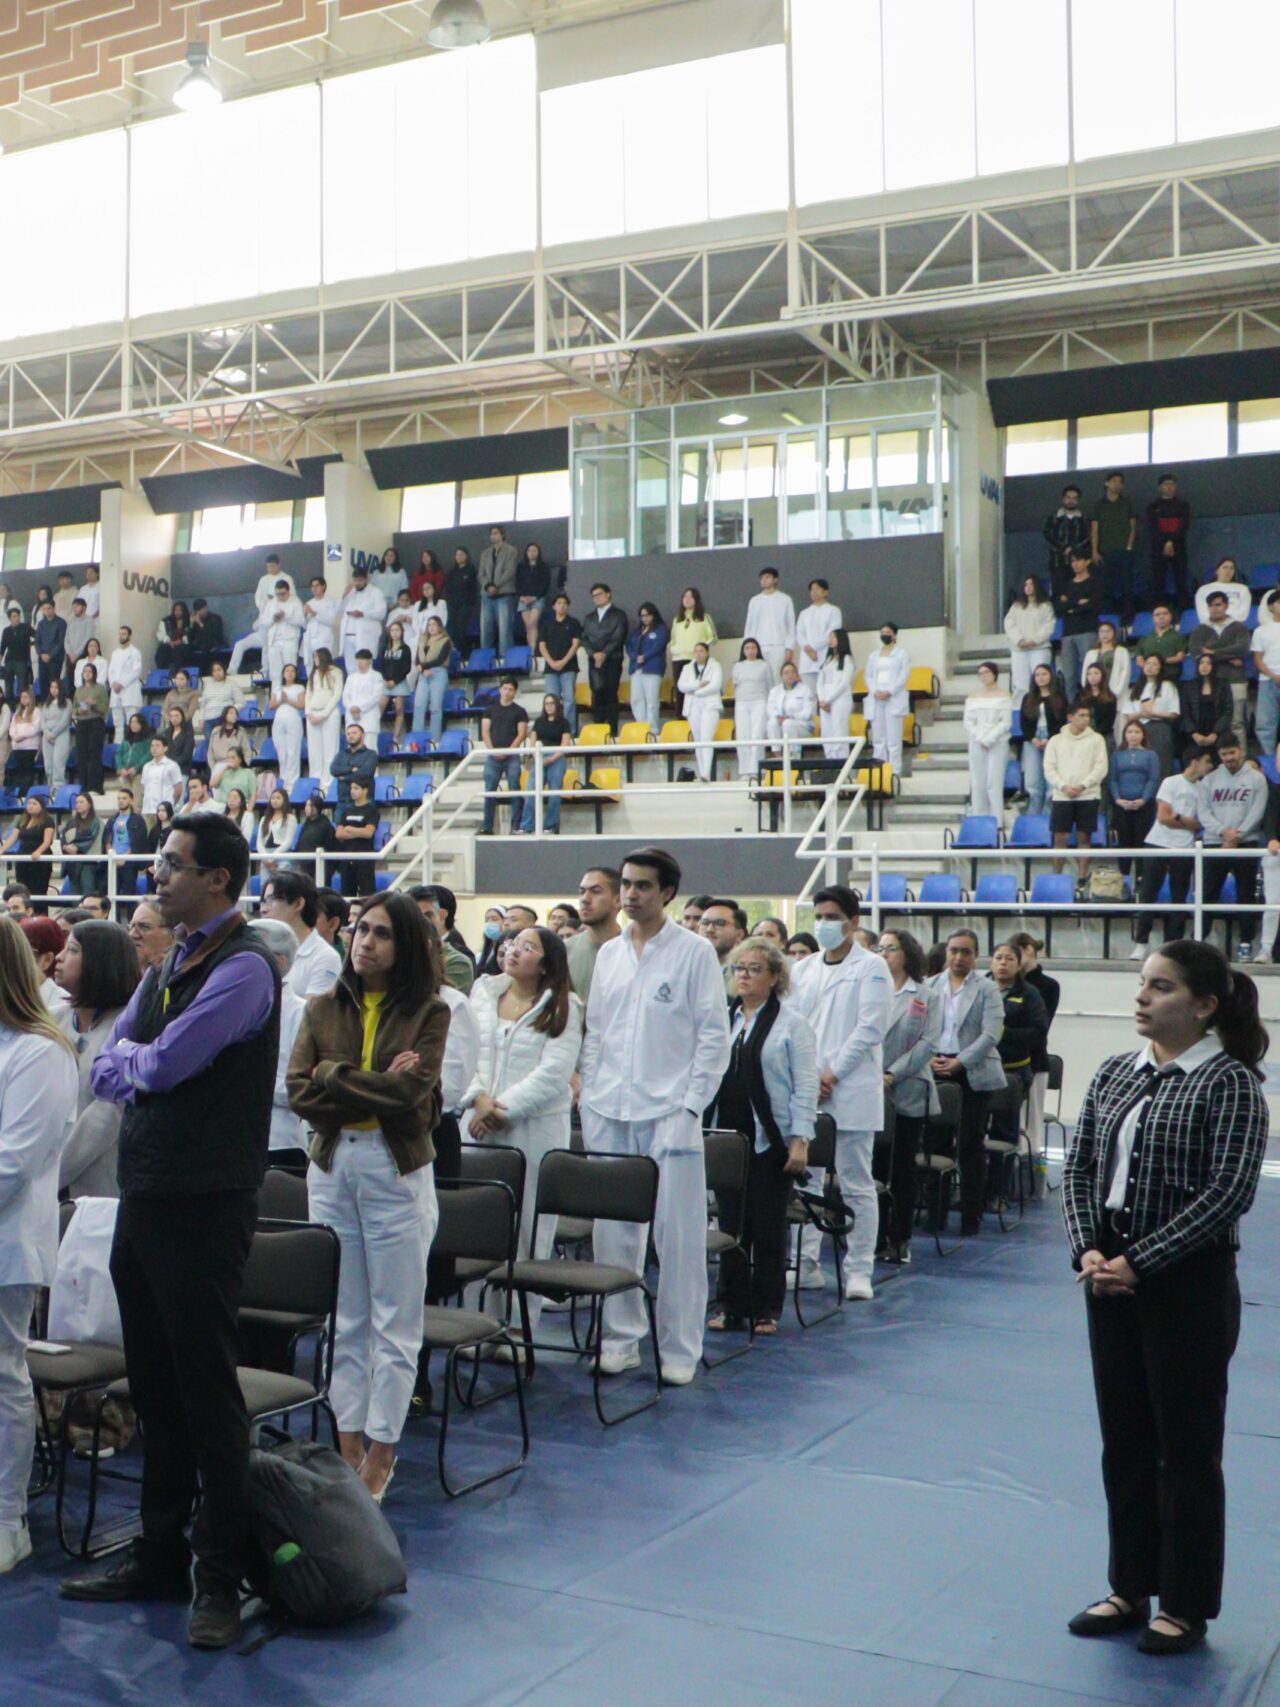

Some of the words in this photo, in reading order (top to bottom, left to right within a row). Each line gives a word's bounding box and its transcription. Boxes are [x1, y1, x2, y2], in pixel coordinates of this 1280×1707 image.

[349, 547, 380, 573] UVA
[123, 570, 169, 598] UVAQ
[1212, 788, 1251, 802] NIKE
